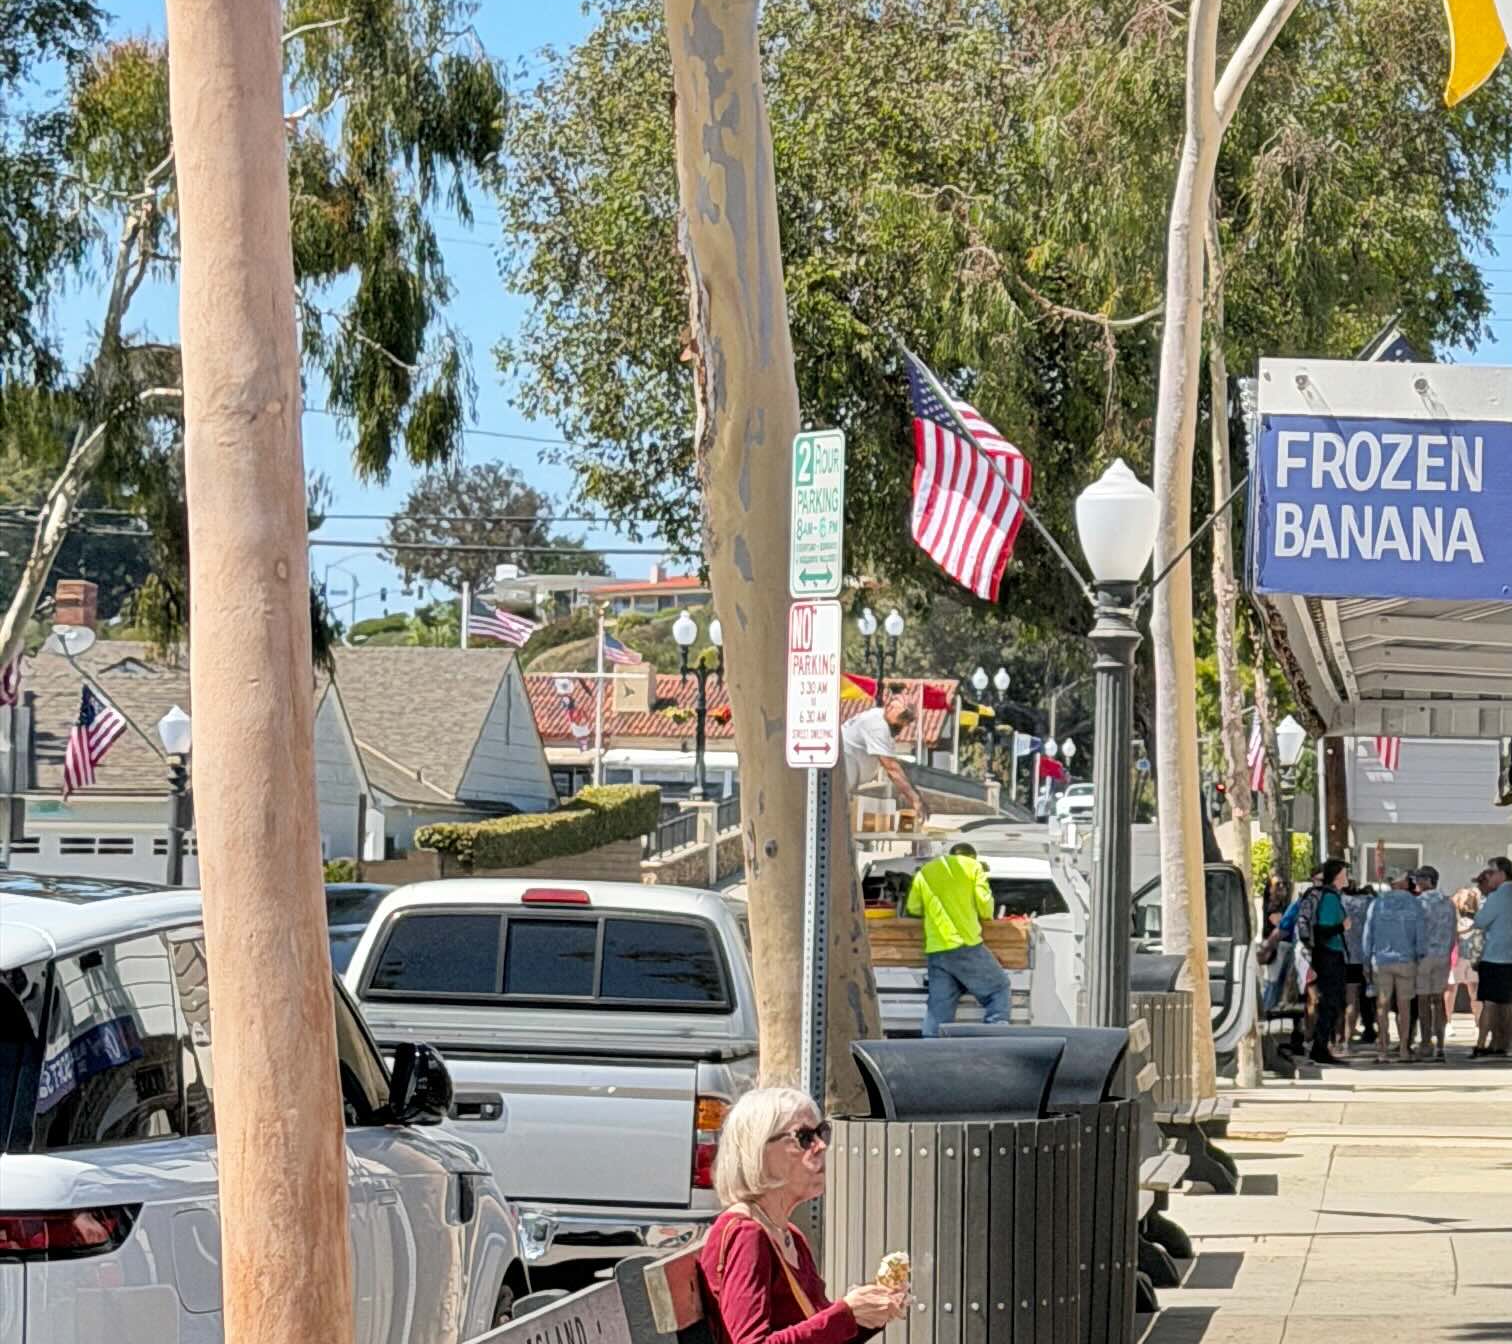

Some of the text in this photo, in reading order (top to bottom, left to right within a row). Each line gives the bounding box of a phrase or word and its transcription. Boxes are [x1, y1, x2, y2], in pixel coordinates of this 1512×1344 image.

[797, 440, 812, 482] 2
[1276, 430, 1484, 492] FROZEN
[797, 488, 839, 513] PARKING
[1274, 502, 1485, 564] BANANA
[792, 606, 812, 650] NO
[792, 653, 836, 676] PARKING
